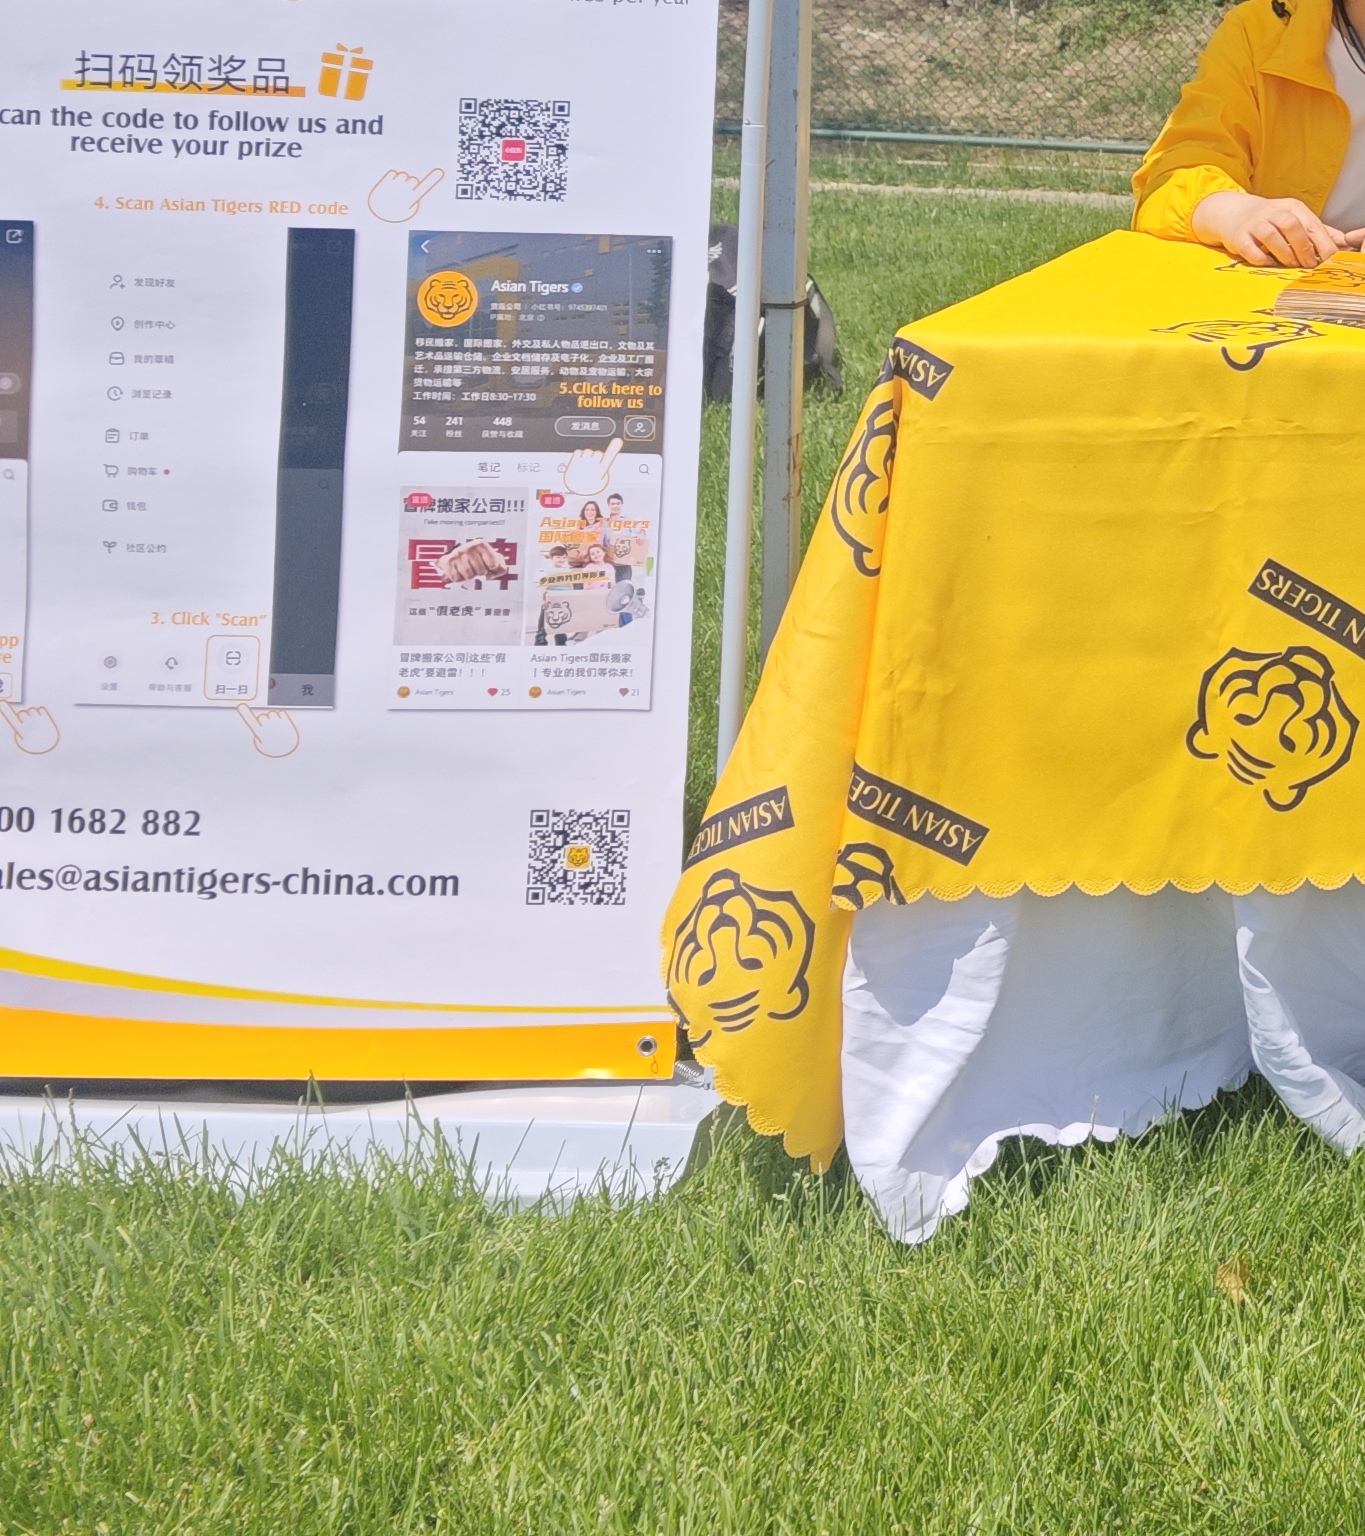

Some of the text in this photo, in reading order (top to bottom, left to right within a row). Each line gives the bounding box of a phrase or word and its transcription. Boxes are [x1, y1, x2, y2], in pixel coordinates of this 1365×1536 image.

[73, 49, 292, 95] 扫码领奖品
[50, 106, 93, 127] the
[102, 107, 165, 130] code
[173, 109, 200, 131] to
[207, 109, 290, 134] follow
[298, 117, 328, 135] us
[336, 113, 384, 136] and
[70, 133, 303, 161] receive your prize
[94, 196, 349, 215] 4. Scan Asian Tigers RED code
[133, 277, 176, 289] 发现好友
[490, 279, 570, 295] Asian Tigers
[133, 319, 176, 330] 创作中心
[558, 381, 663, 397] 5.Click here to
[577, 395, 644, 409] follow us
[413, 416, 513, 427] 54 241 448
[477, 462, 541, 473] 笔记 标记
[1256, 566, 1342, 632] TIGERS
[150, 611, 165, 626] 3.
[171, 611, 210, 626] Click
[530, 653, 558, 663] Asian
[214, 684, 249, 695] 扫一扫
[300, 683, 315, 697] 我
[500, 688, 511, 697] 25
[630, 688, 640, 697] 21
[50, 807, 127, 835] 1682
[140, 809, 202, 837] 882
[728, 795, 788, 840] ASIAN
[902, 803, 983, 854] ASIAN
[0, 861, 460, 901] les@asiantigers-china.com
